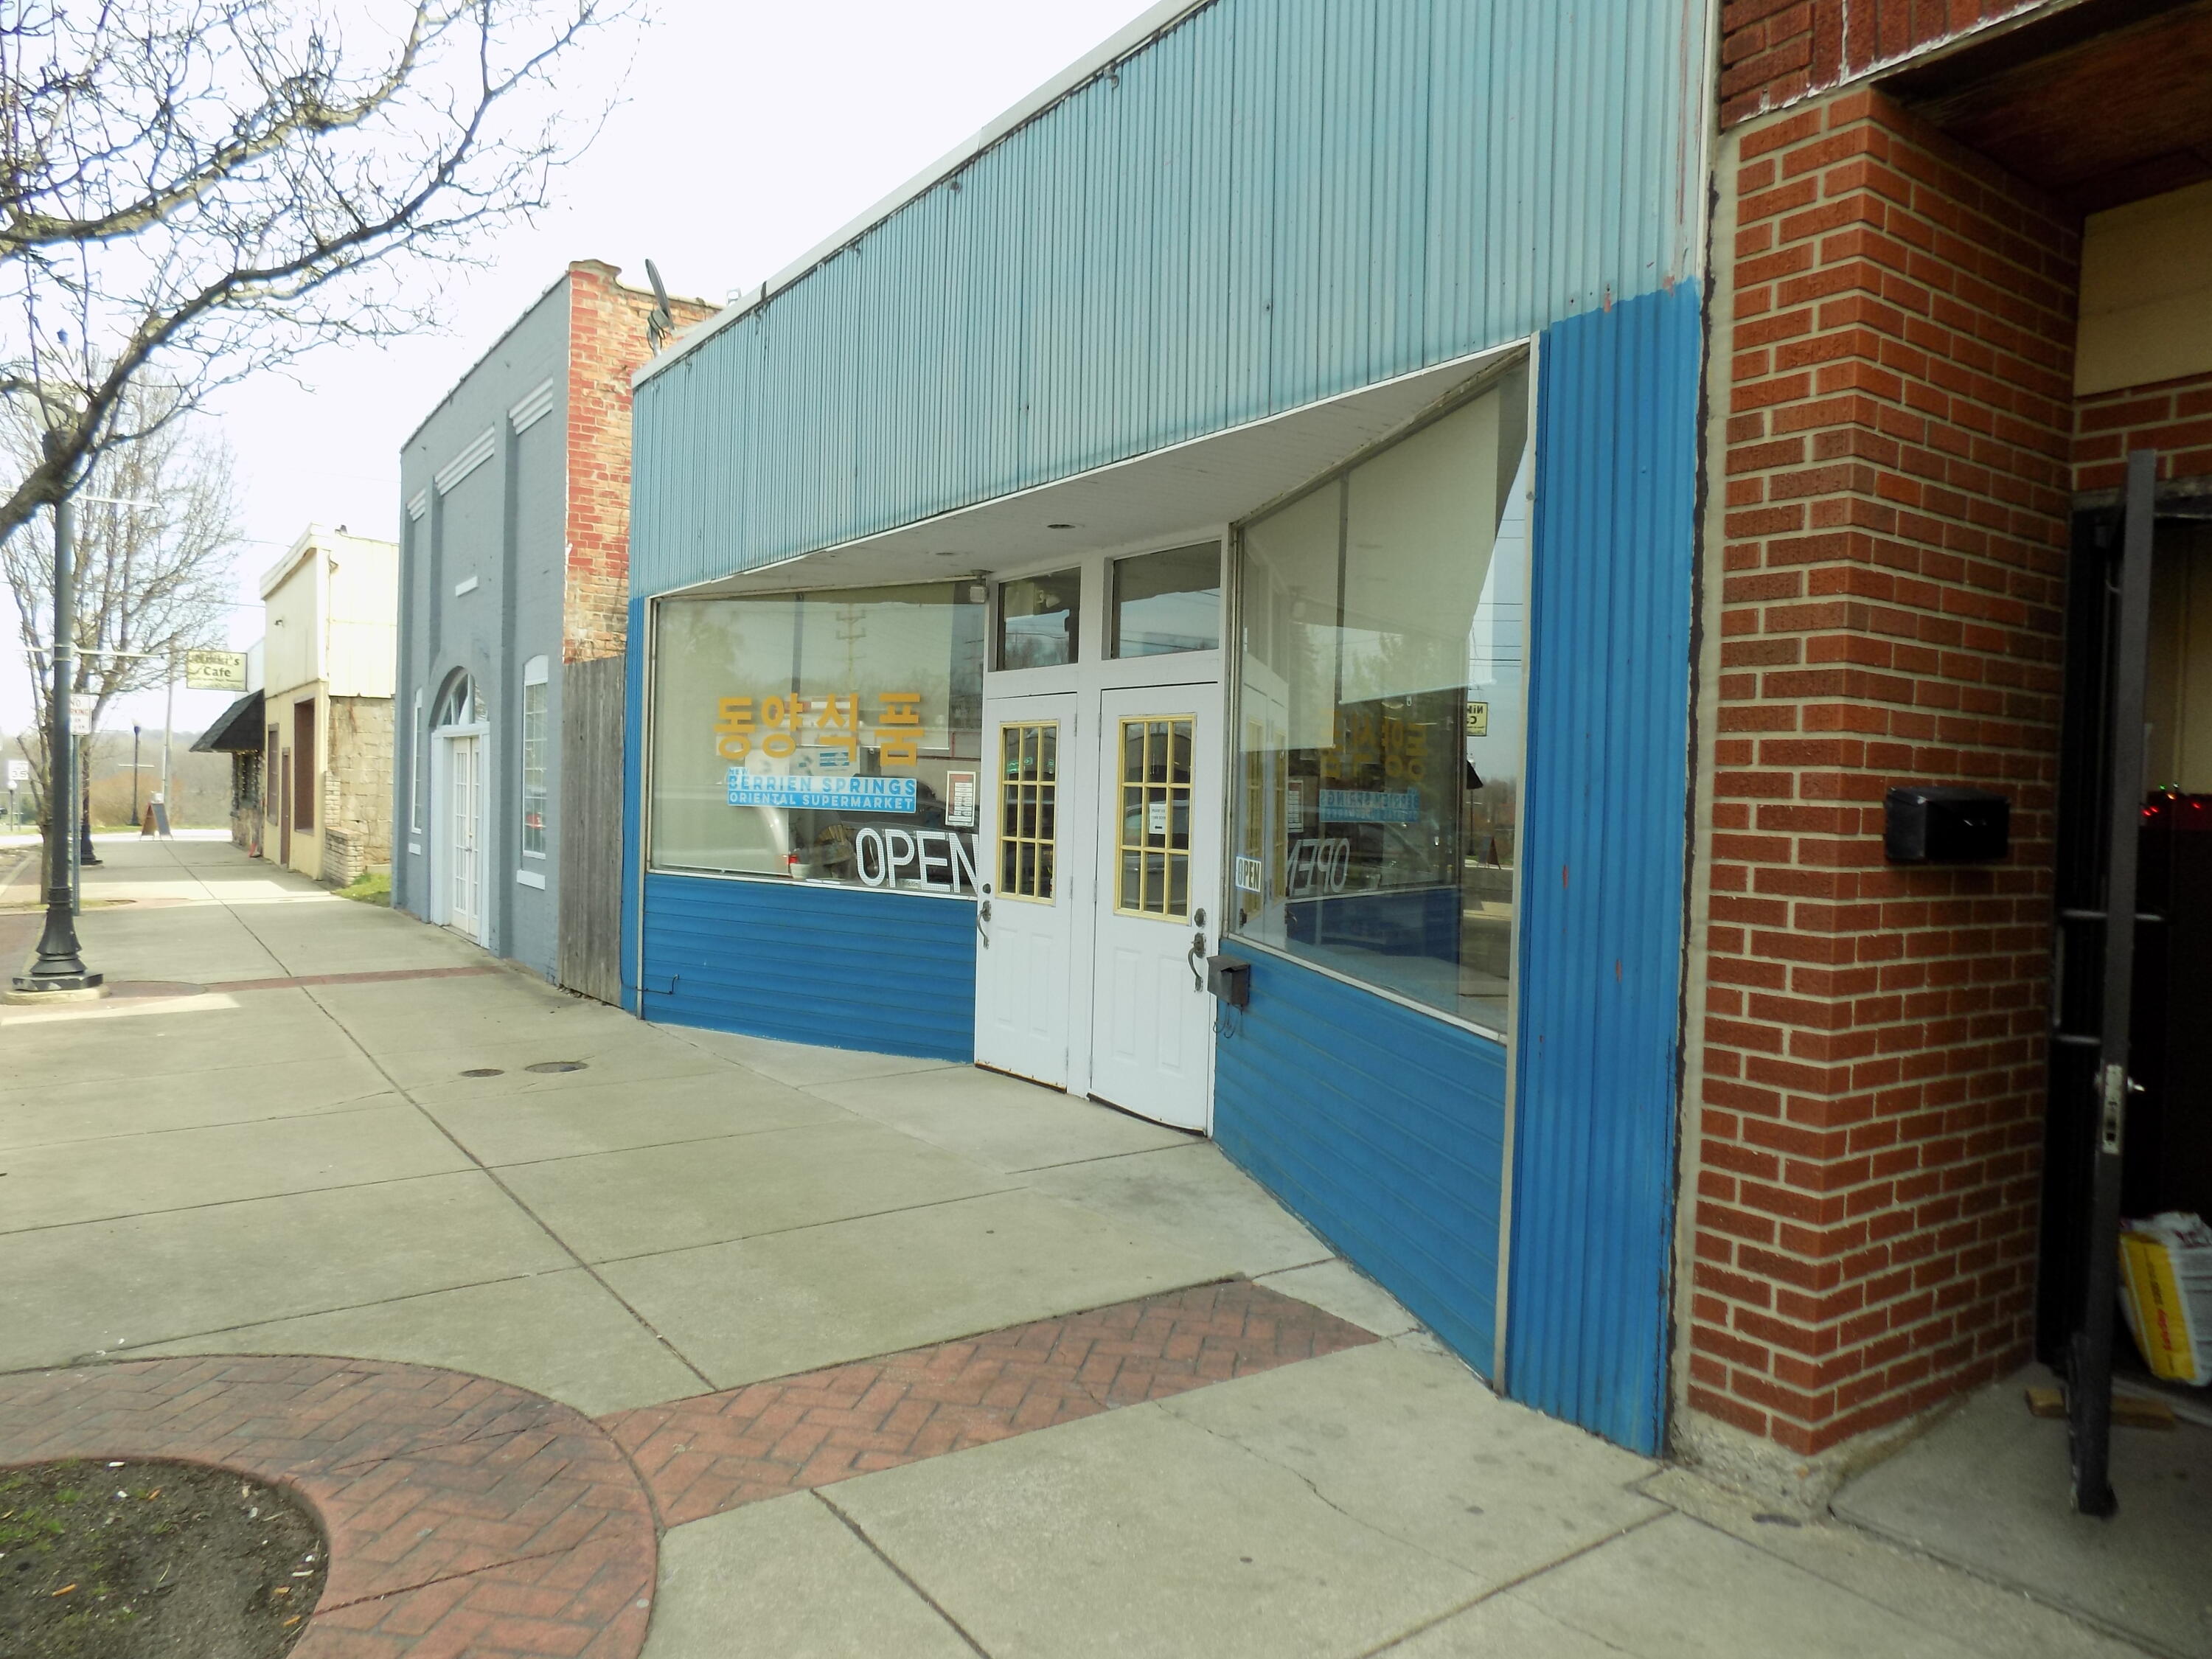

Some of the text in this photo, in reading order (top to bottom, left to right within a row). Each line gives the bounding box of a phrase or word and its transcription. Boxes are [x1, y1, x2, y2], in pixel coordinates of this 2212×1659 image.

[204, 666, 232, 677] Cafe
[714, 692, 924, 768] 동양식품
[728, 775, 916, 796] BERRIEN SPRINGS
[729, 792, 913, 810] ORIENTAL SUPERMARKET
[855, 827, 980, 894] OPEN
[1237, 858, 1260, 891] OPEN
